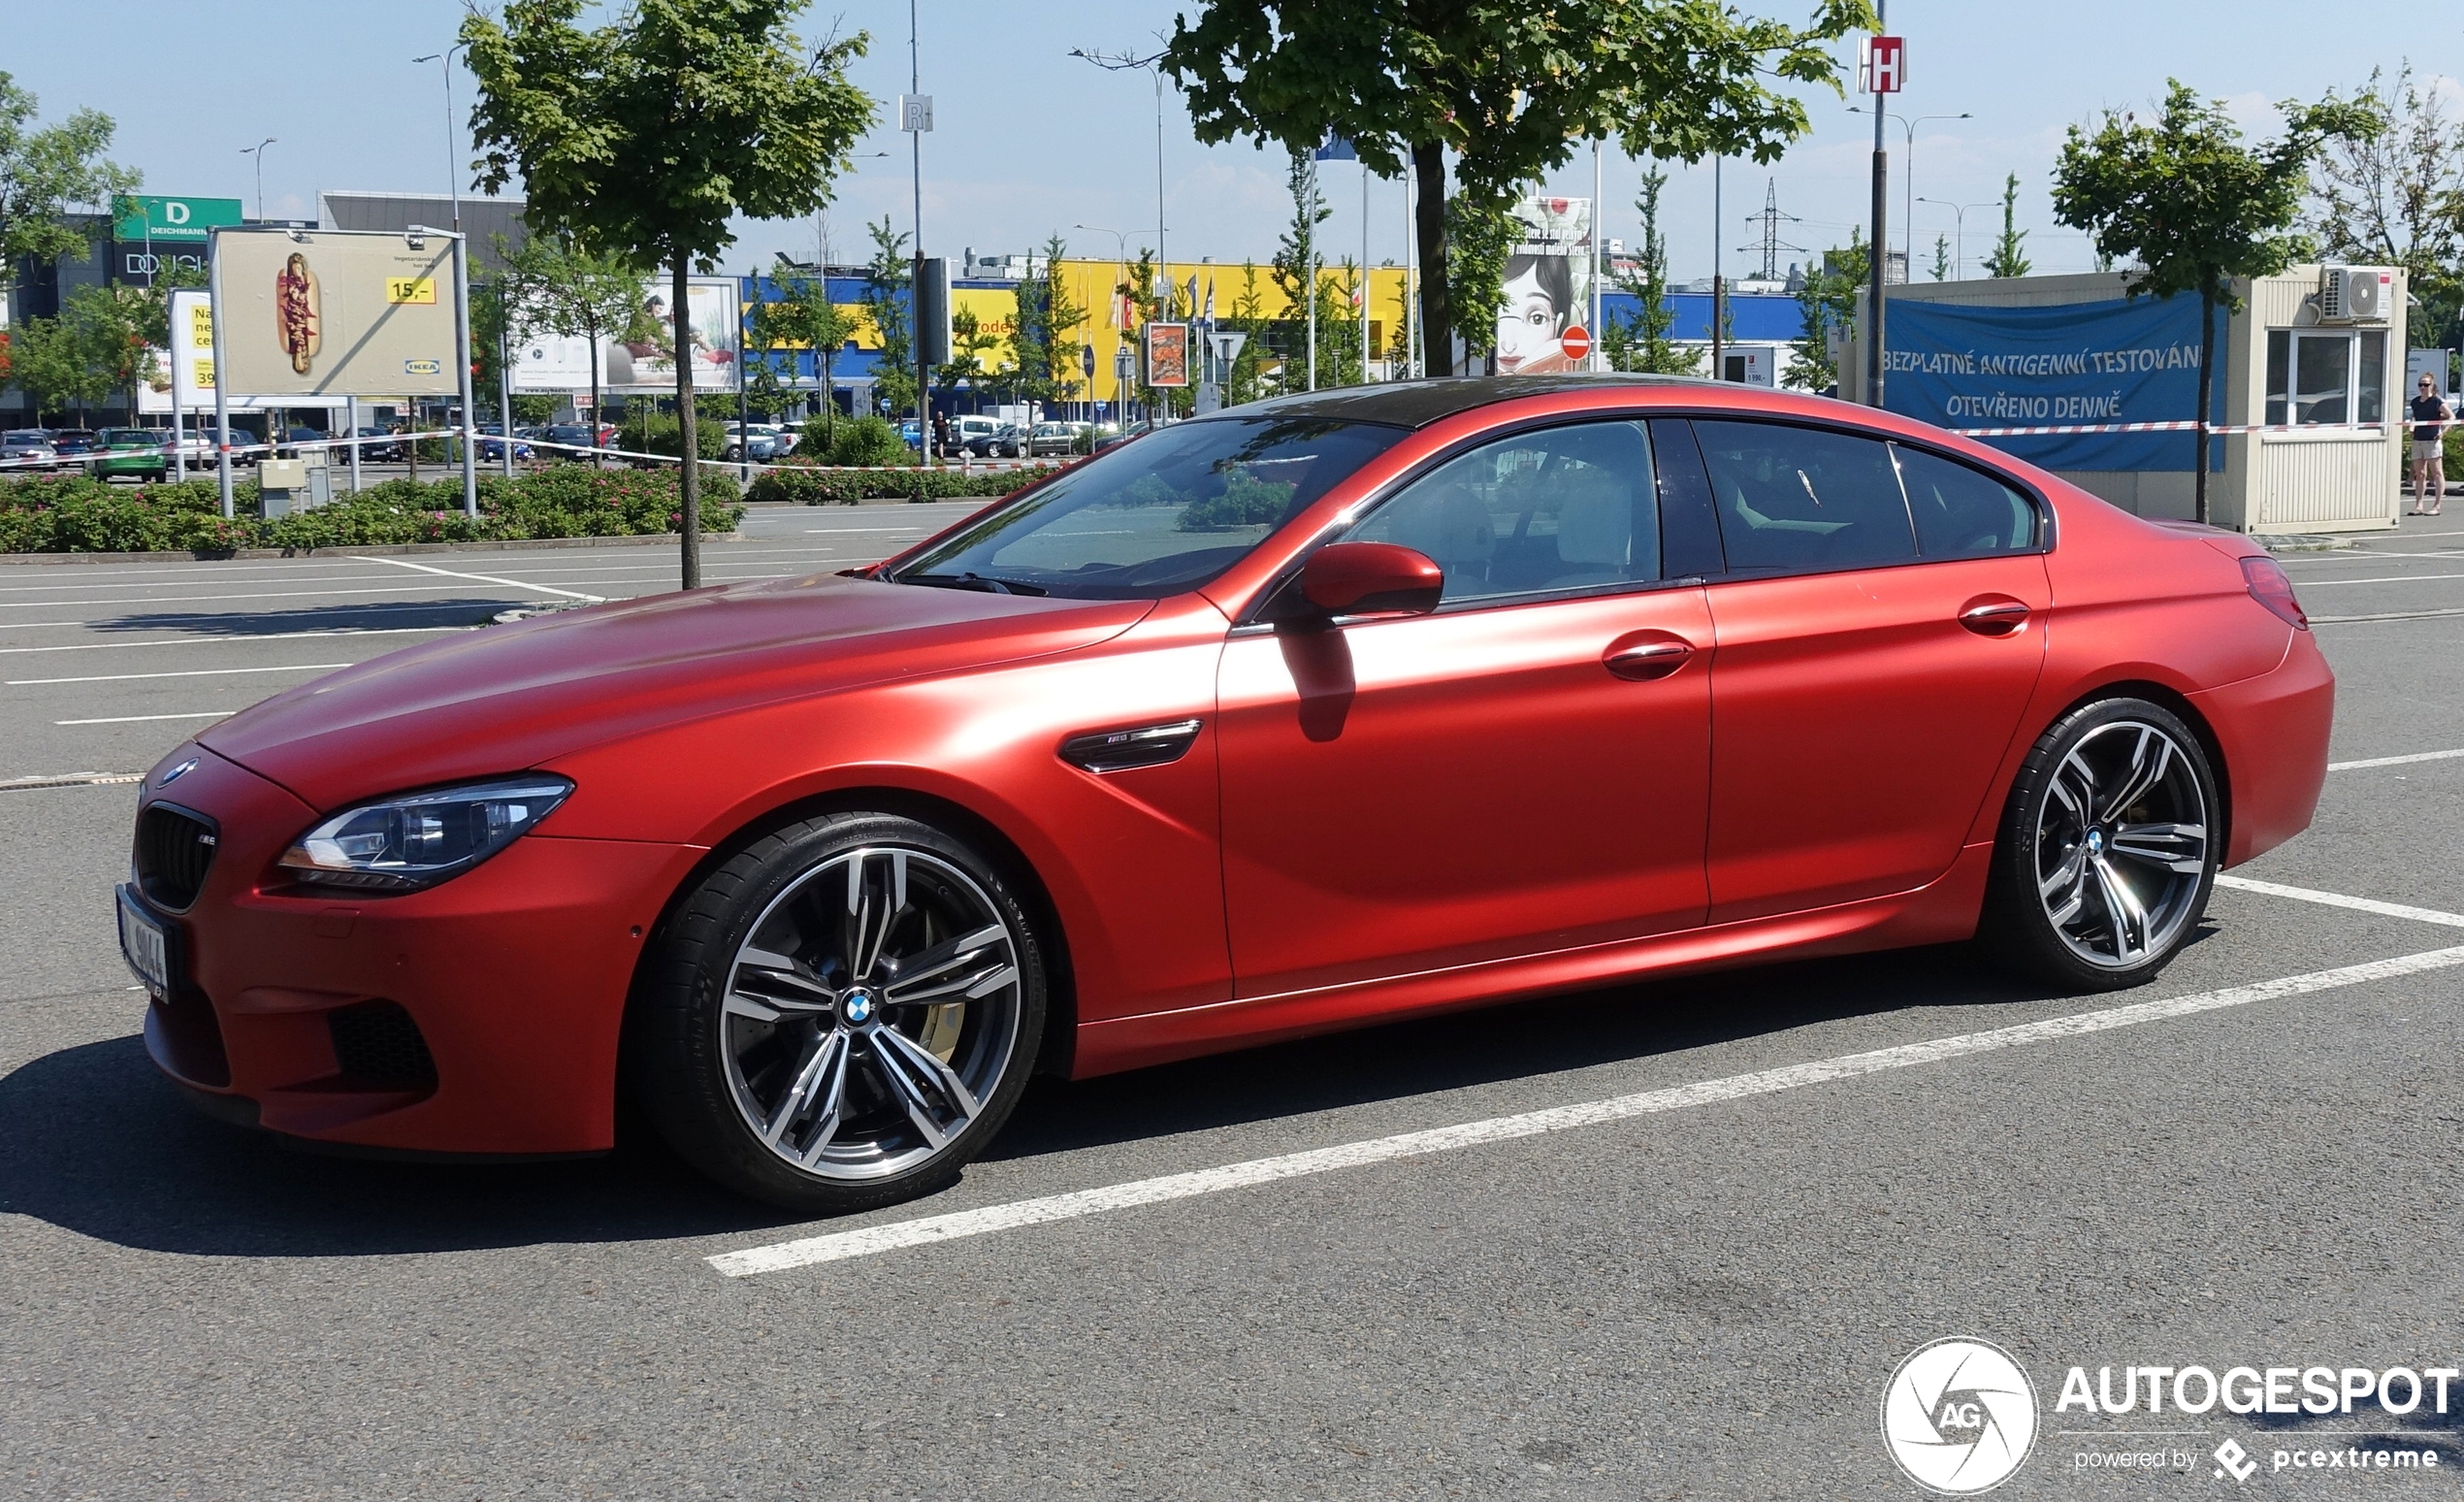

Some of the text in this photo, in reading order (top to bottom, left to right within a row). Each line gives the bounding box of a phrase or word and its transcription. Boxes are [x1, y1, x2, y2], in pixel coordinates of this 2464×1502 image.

[1873, 49, 1899, 90] H
[906, 103, 924, 129] R
[166, 202, 190, 224] D
[150, 227, 207, 236] DEICHMANN
[1883, 349, 1976, 375] BEZPLATNÉ
[1980, 347, 2089, 376] ANTIGENNÍ
[1946, 390, 2123, 418] OTEVŘENO DENNĚ
